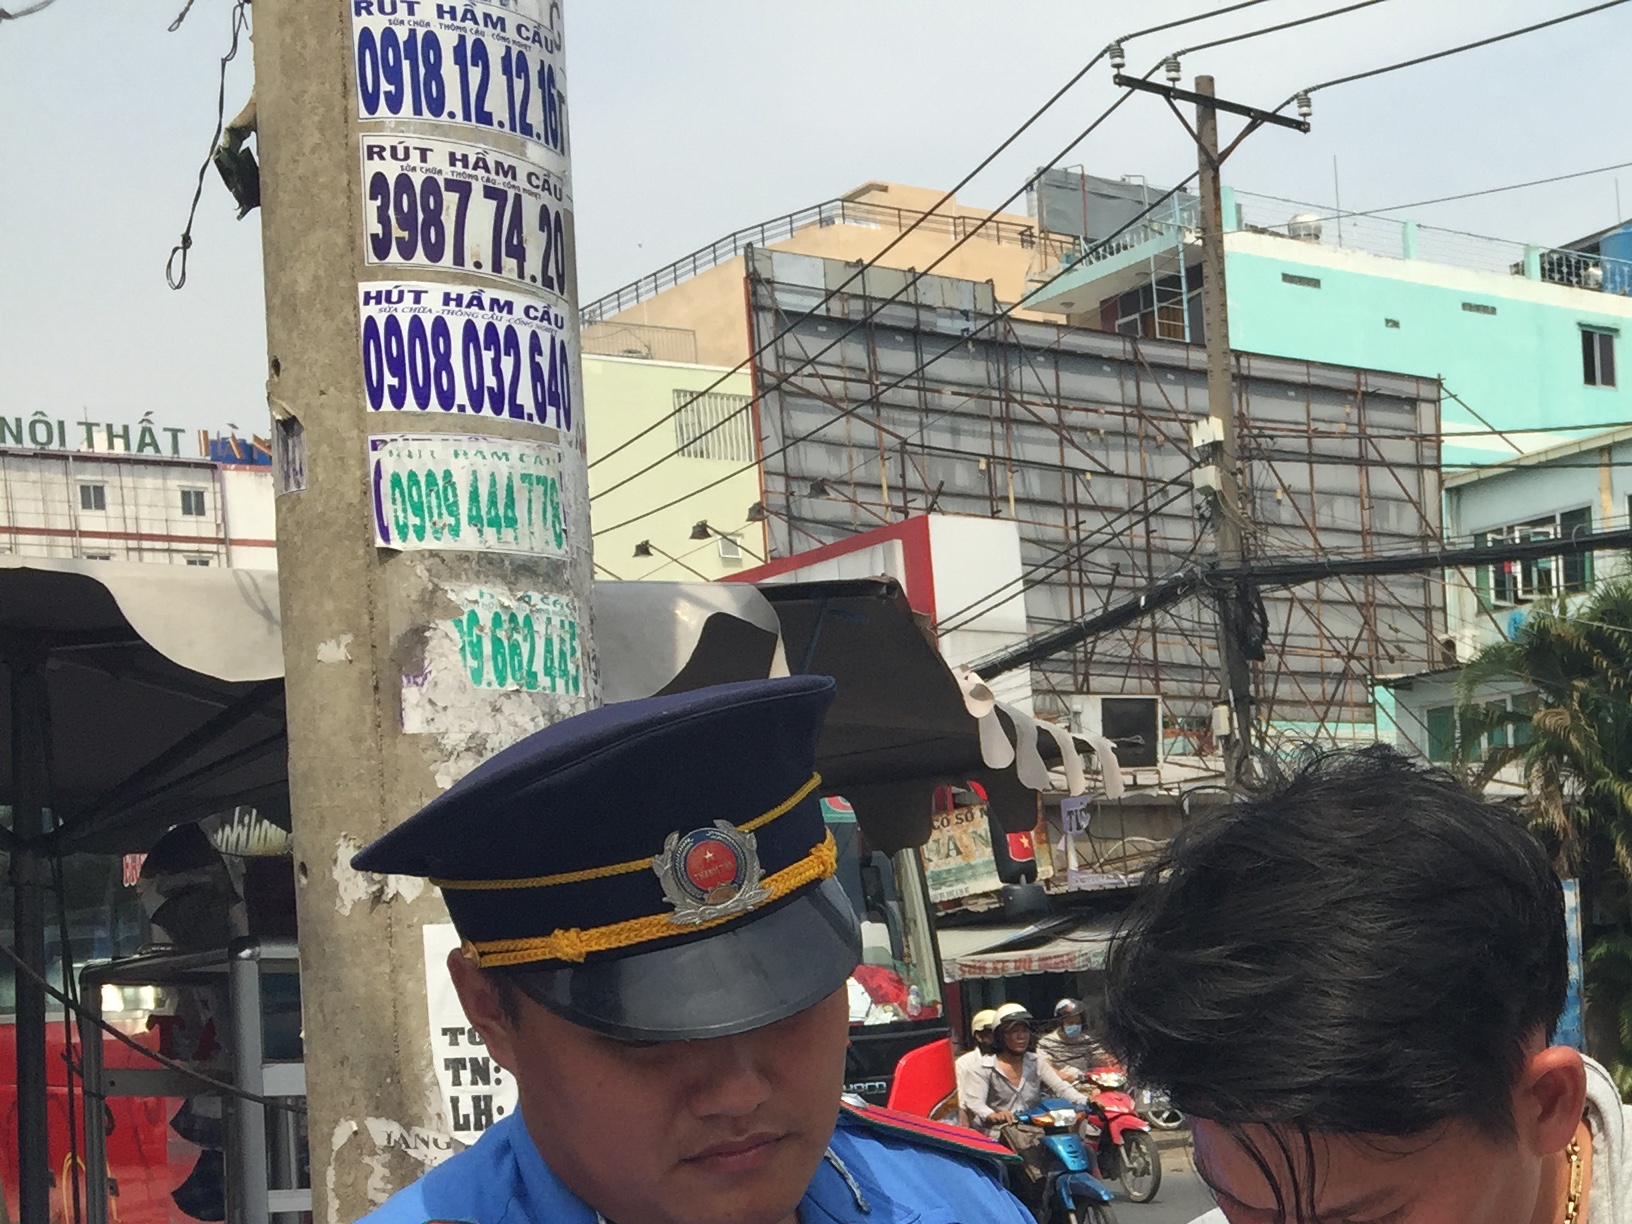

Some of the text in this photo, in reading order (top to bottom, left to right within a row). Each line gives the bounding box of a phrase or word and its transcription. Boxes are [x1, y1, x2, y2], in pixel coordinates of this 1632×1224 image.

[436, 1, 507, 33] HẦM
[515, 23, 554, 54] CẦU
[366, 140, 563, 202] RÚT HẦM CẦU
[369, 171, 565, 296] 3987.74.20
[363, 285, 565, 330] HÚT HẦM CẦU
[362, 313, 571, 432] 0908.032.640
[0, 410, 66, 451] NỘI
[77, 410, 186, 458] THẤT
[467, 469, 518, 545] 444
[444, 1057, 502, 1087] TN:
